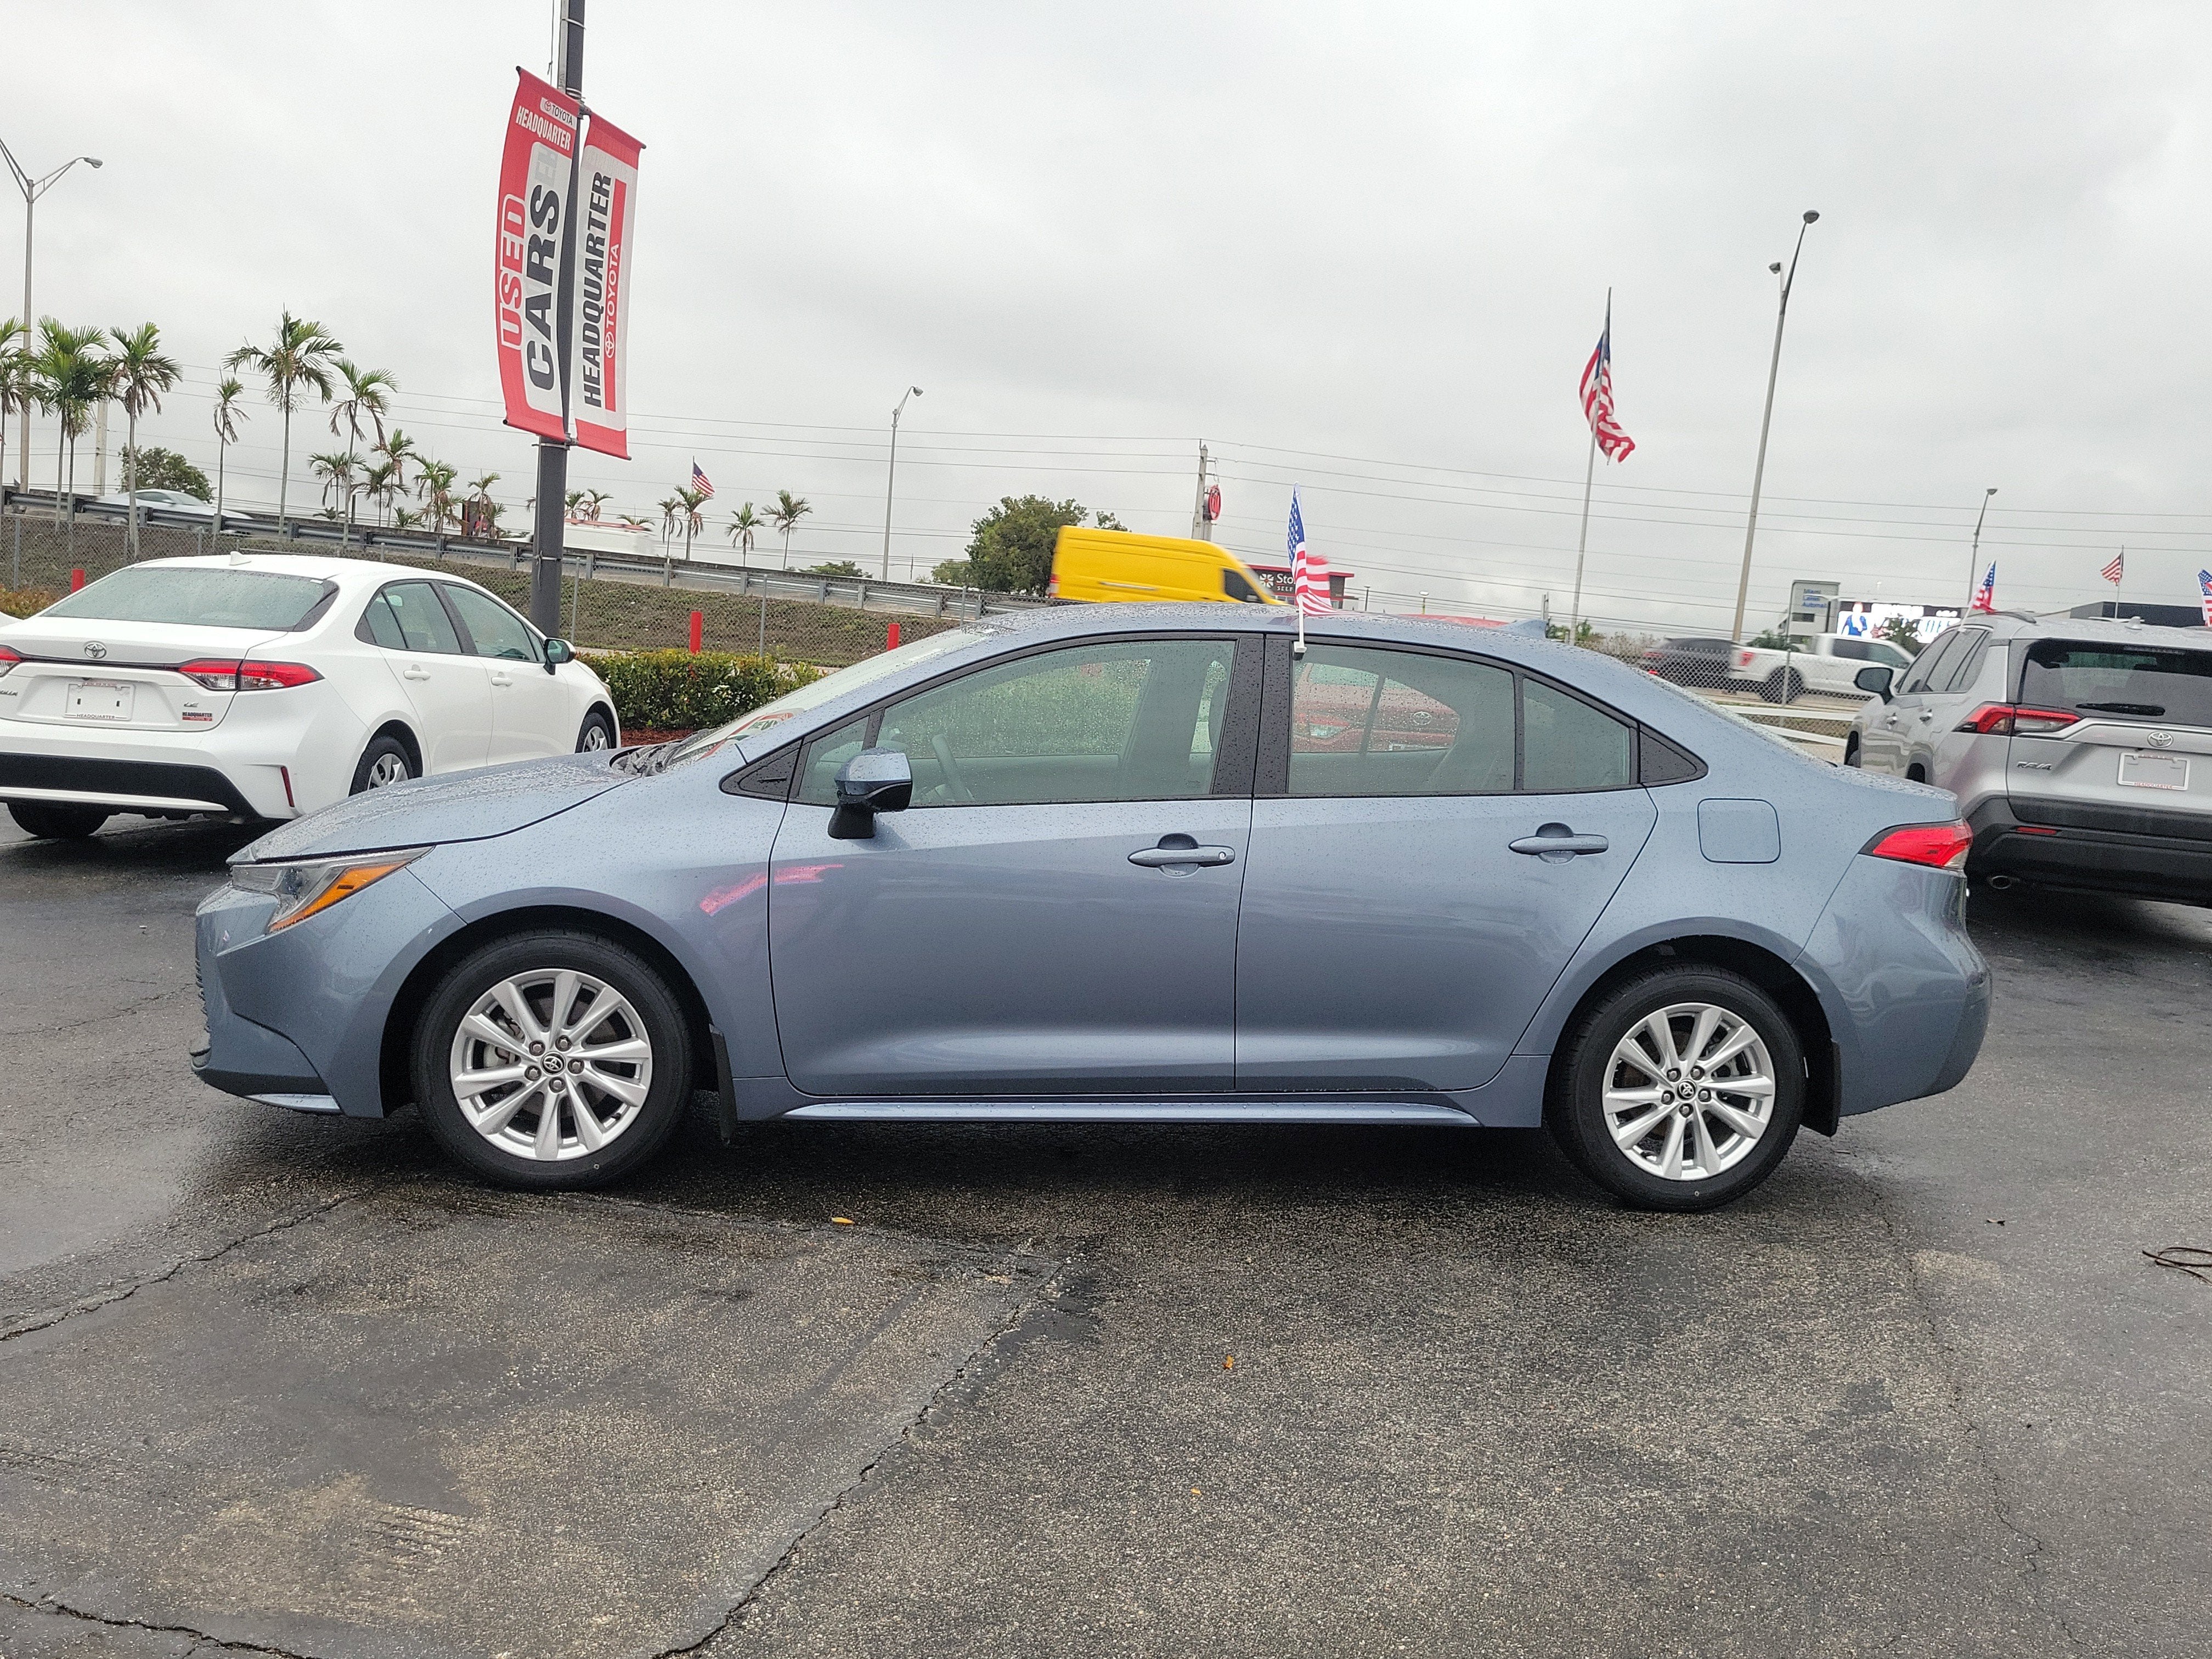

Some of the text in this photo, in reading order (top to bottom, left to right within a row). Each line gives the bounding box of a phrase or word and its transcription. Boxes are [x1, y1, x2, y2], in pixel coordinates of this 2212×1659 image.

[516, 105, 572, 151] HEADQUARTER
[552, 105, 573, 126] TOYOTA
[499, 194, 526, 351] USED
[525, 184, 560, 391] CARS
[582, 172, 612, 408] HEADQUARTER
[606, 243, 619, 327] TOYOTA
[1276, 573, 1296, 585] Sto
